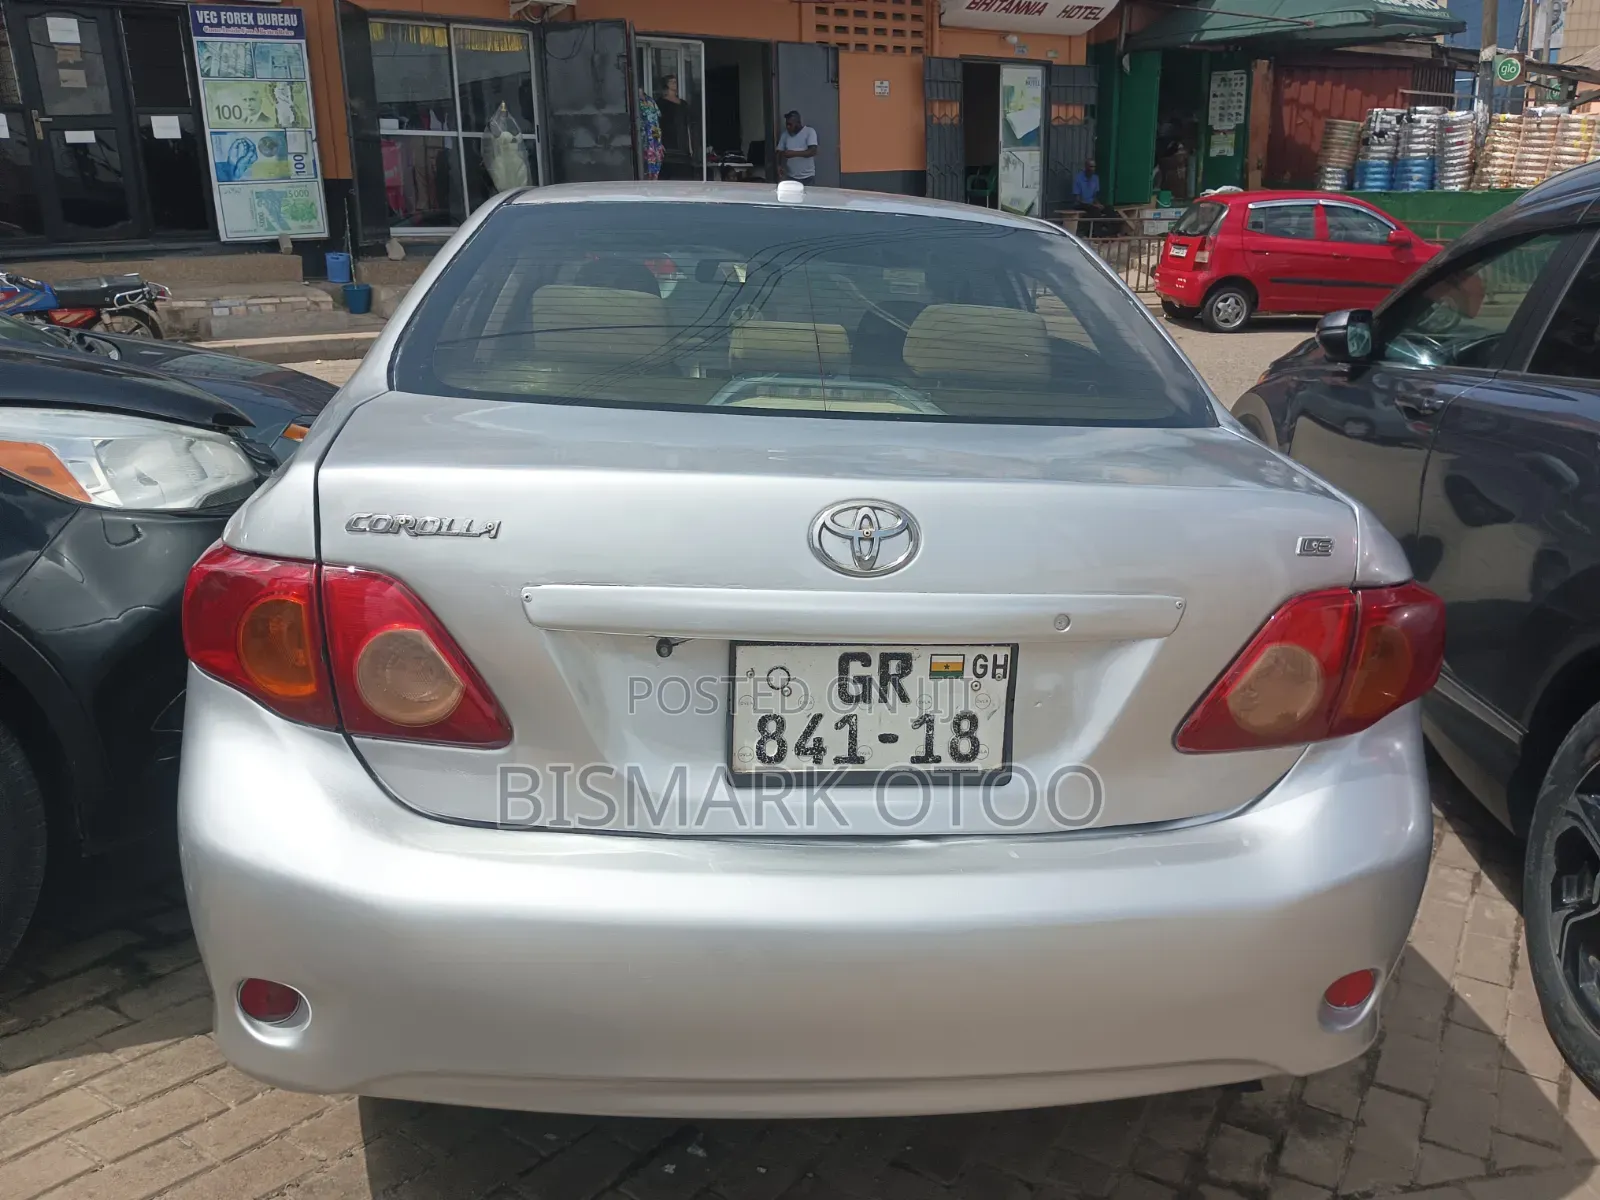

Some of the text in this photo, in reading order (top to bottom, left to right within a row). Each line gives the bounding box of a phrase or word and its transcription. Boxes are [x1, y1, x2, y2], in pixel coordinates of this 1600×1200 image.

[220, 11, 255, 25] FOREX
[256, 13, 298, 26] BUREAU
[965, 0, 1104, 20] BRITANNIA HOTEL
[1501, 64, 1516, 75] glo
[215, 104, 243, 120] 100
[293, 155, 306, 175] 100
[345, 513, 501, 539] COROLLA
[1299, 537, 1332, 555] LE
[972, 654, 1008, 679] GH
[838, 652, 912, 704] GR
[755, 713, 981, 765] 841-18
